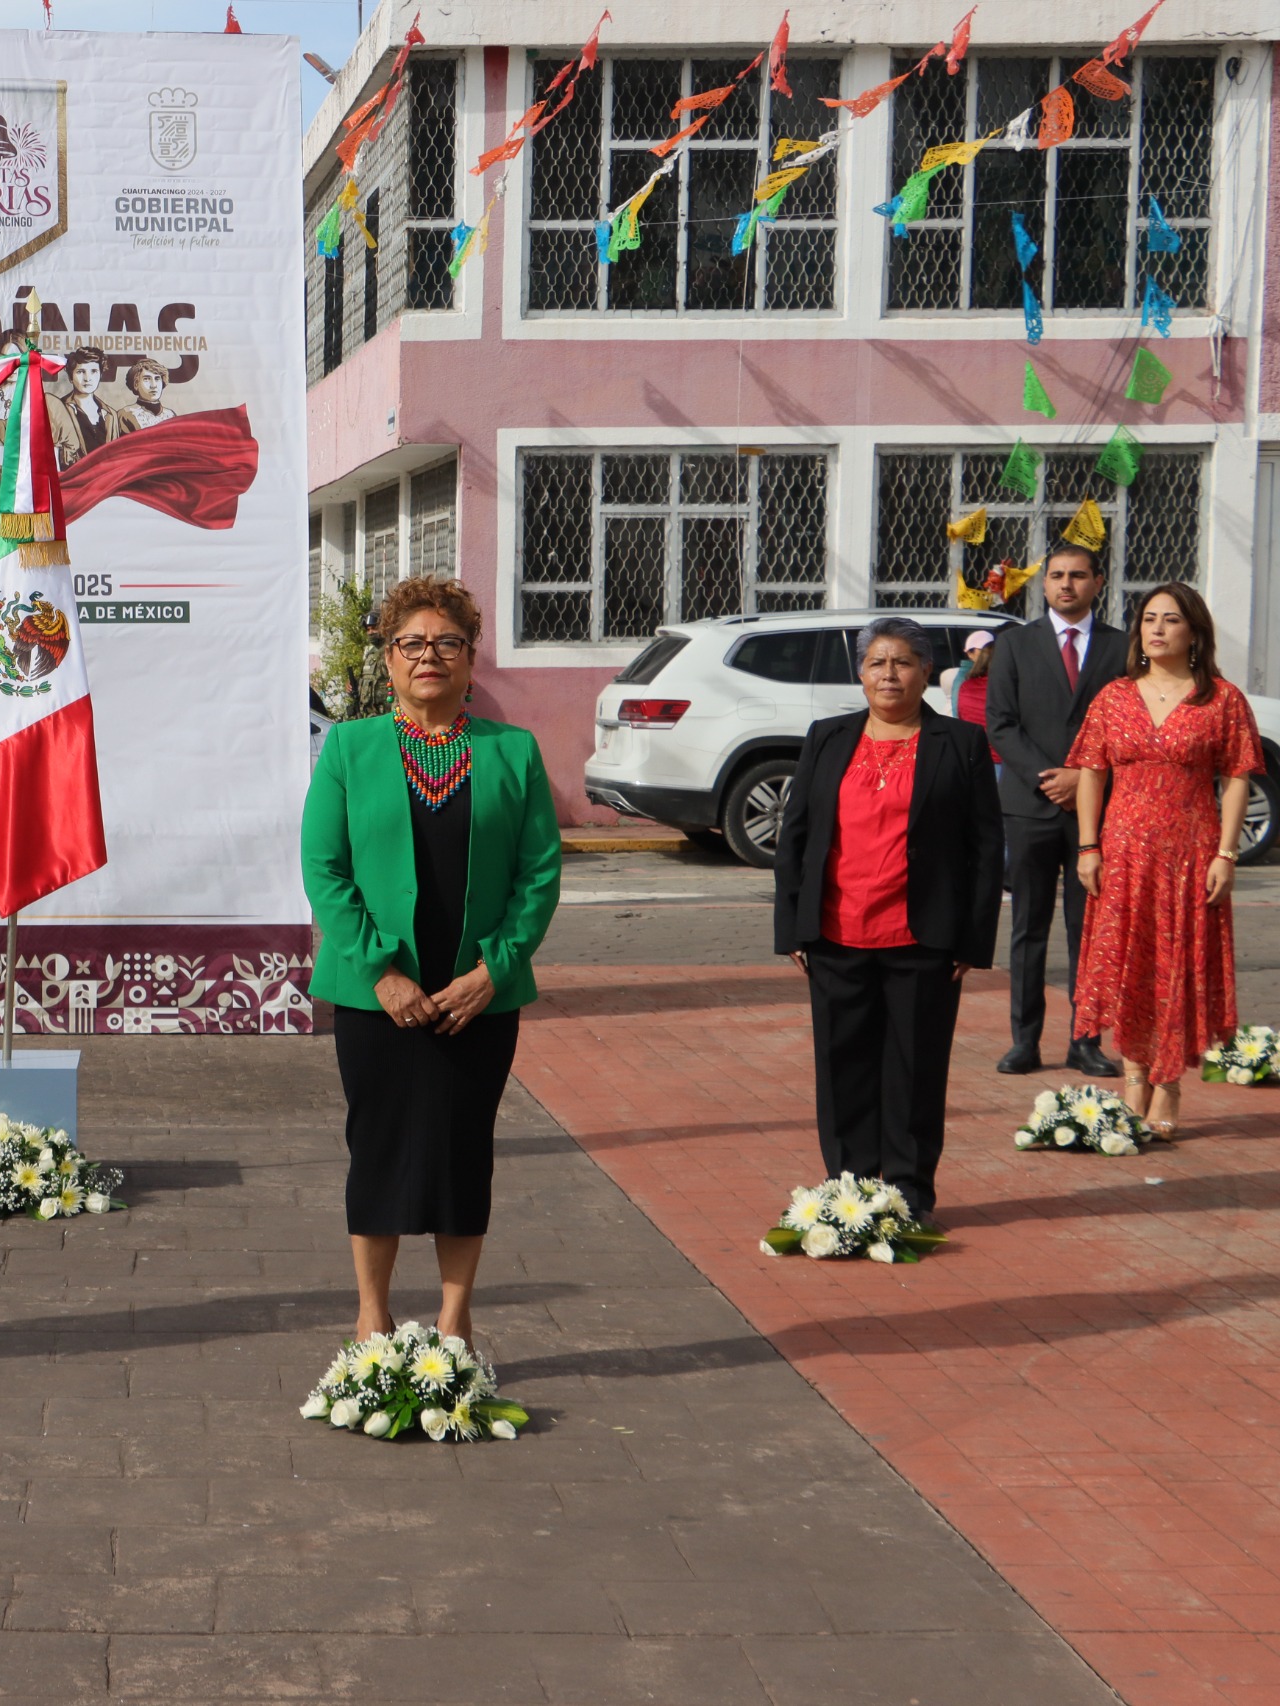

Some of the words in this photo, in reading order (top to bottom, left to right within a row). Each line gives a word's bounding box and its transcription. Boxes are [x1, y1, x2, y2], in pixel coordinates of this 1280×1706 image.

[115, 196, 234, 215] GOBIERNO
[115, 216, 235, 232] MUNICIPAL
[130, 233, 174, 250] Tradición
[178, 238, 186, 250] y
[43, 335, 61, 351] DE
[66, 335, 83, 351] LA
[88, 335, 208, 352] INDEPENDENCIA
[74, 573, 113, 597] 025
[95, 606, 117, 619] DE
[122, 603, 184, 619] MÉXICO
